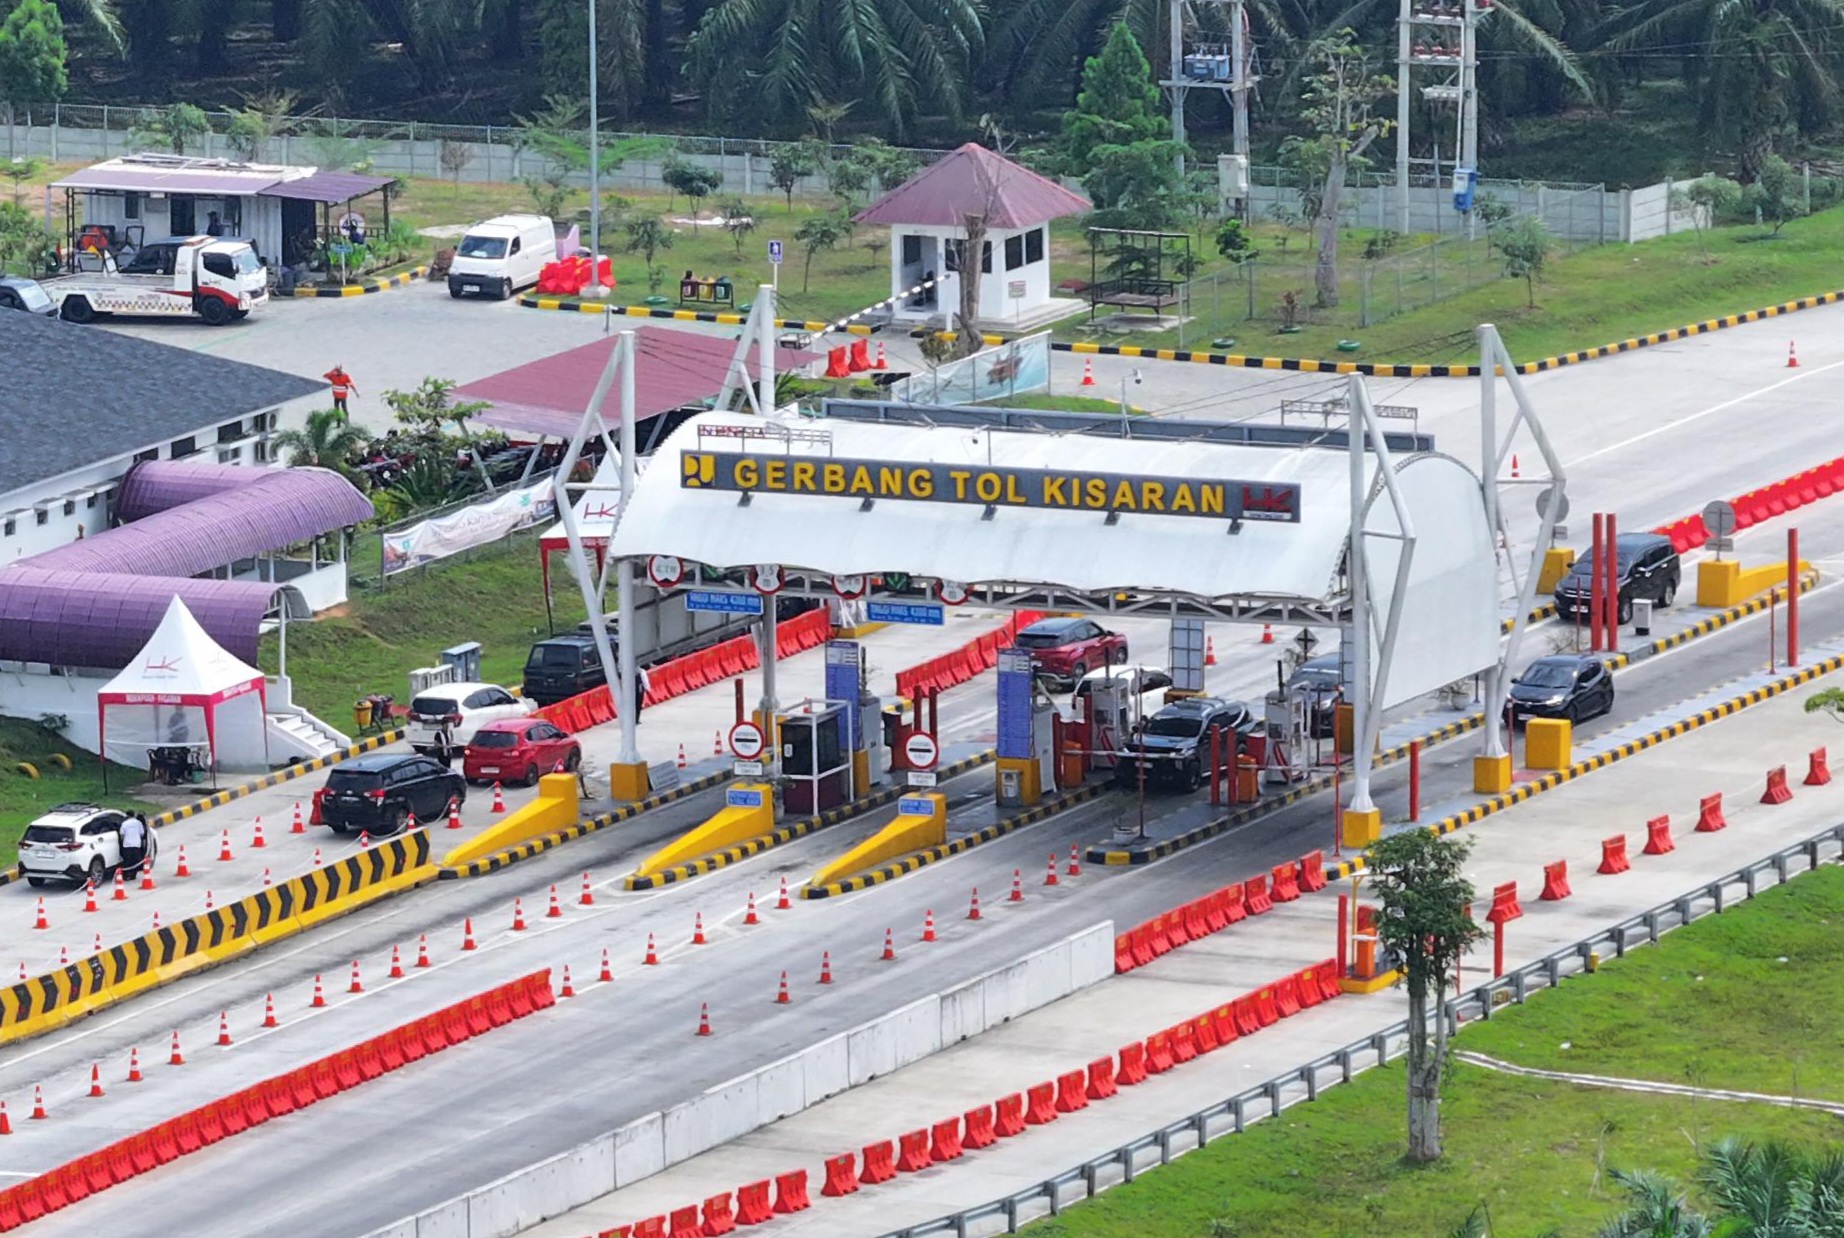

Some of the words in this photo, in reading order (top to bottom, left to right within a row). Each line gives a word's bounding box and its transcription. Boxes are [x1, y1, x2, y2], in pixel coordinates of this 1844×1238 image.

[734, 460, 933, 498] GERBANG
[951, 471, 1026, 504] TOL
[1043, 478, 1224, 513] KISARAN
[1243, 485, 1292, 512] HK
